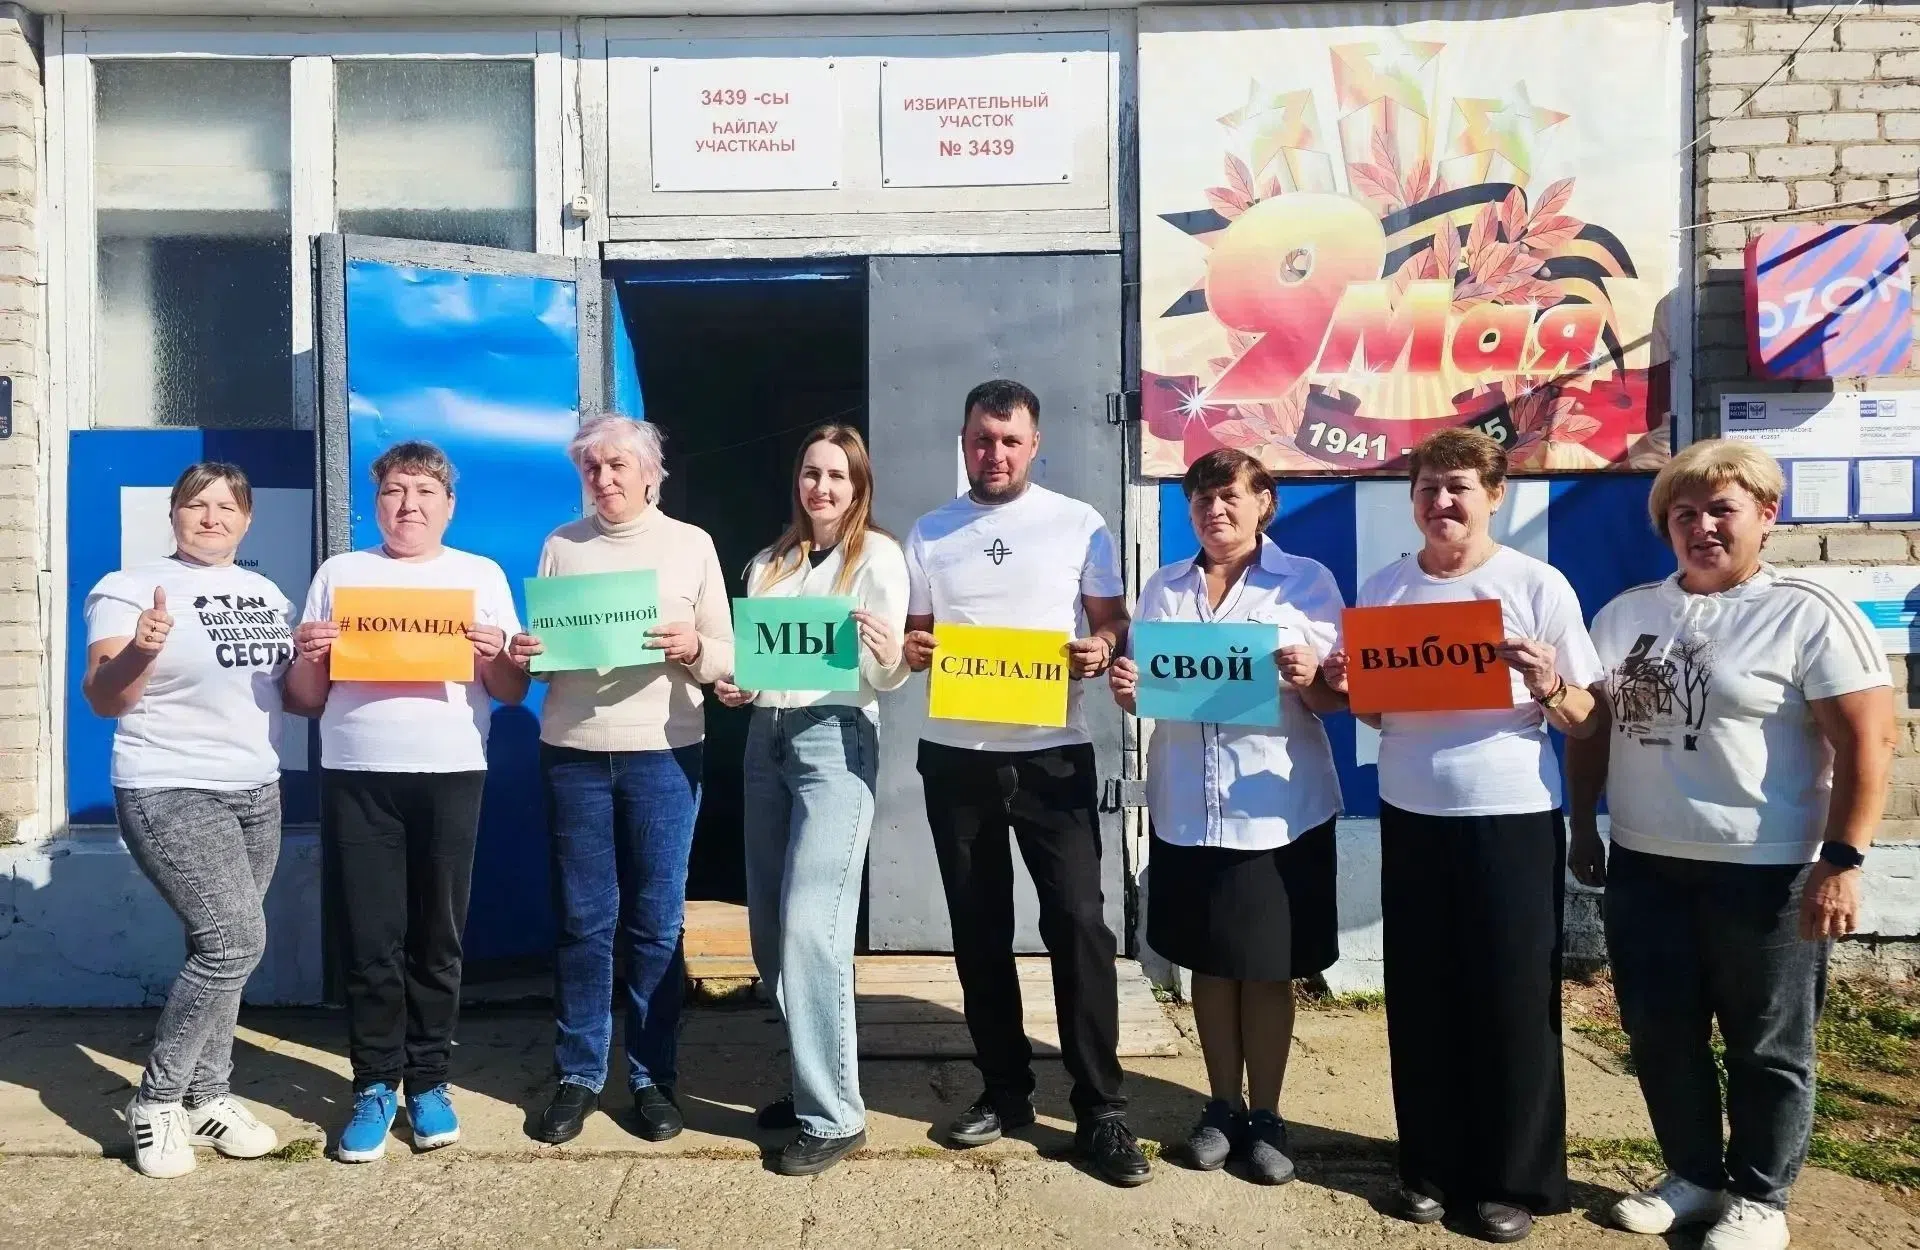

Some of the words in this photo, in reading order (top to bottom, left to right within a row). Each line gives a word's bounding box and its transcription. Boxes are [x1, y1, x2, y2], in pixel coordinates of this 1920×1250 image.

[701, 89, 747, 106] 3439
[904, 92, 1049, 111] ИЗБИРАТЕЛЬНЫЙ
[939, 114, 1014, 128] УЧАСТОК
[939, 140, 962, 157] №
[968, 139, 1014, 156] 3439
[1205, 192, 1388, 404] 9
[1312, 279, 1603, 377] Мая
[1758, 262, 1912, 338] OZON
[1309, 421, 1387, 461] 1941
[357, 617, 467, 636] КОМАНДА
[532, 606, 657, 629] #ШАМШУРИНОЙ
[207, 627, 294, 642] ИДЕАЛЬНА
[754, 622, 838, 655] МЫ
[1150, 645, 1254, 681] свой
[1360, 635, 1496, 674] выбор
[940, 656, 1062, 681] СДЕЛАЛИ
